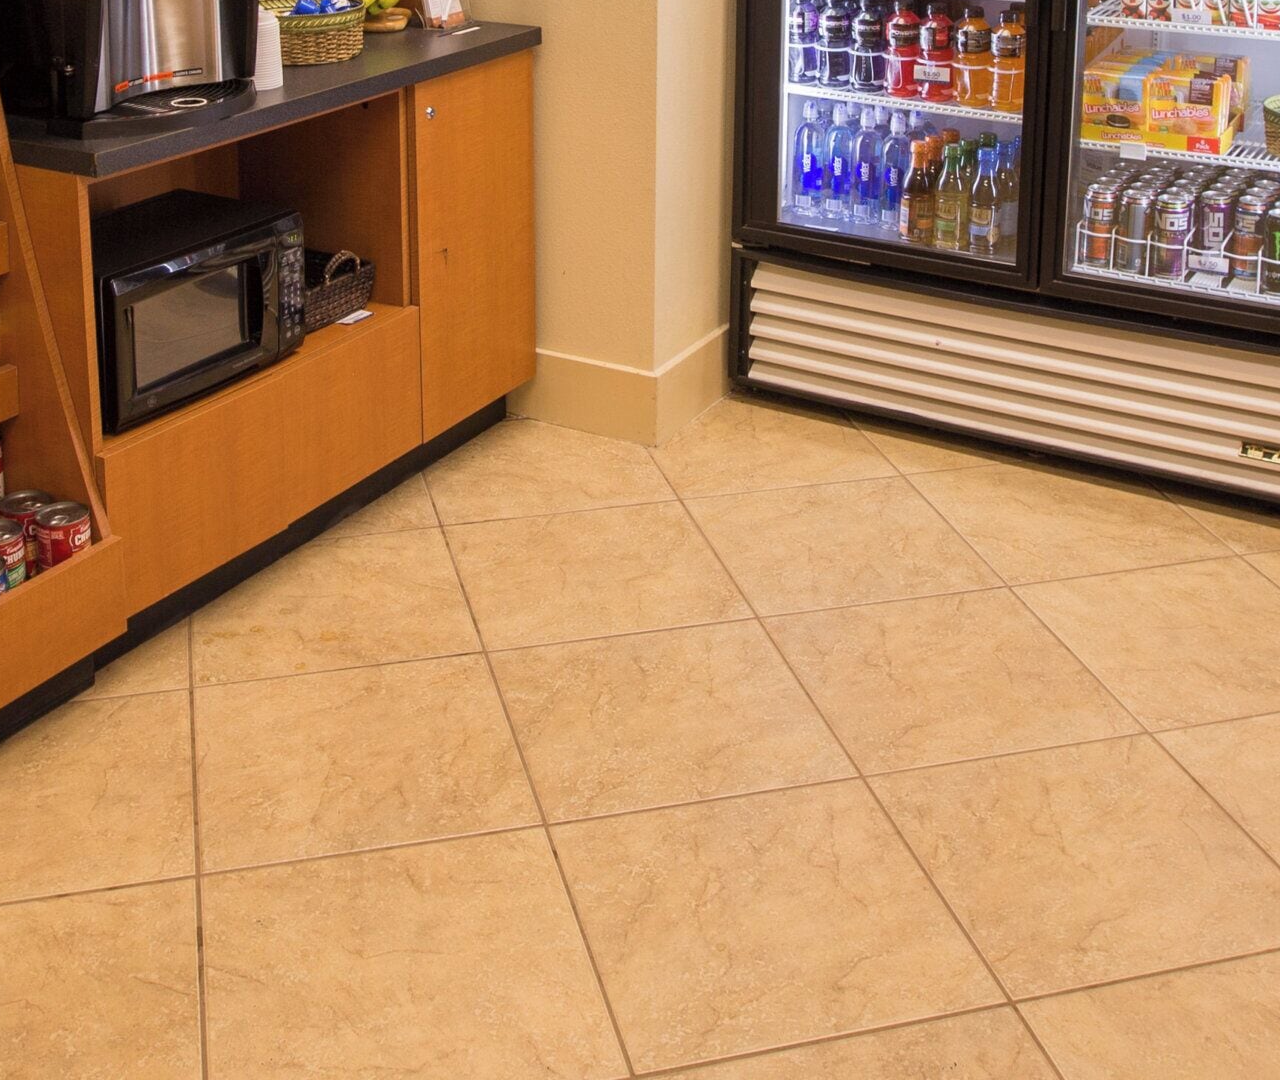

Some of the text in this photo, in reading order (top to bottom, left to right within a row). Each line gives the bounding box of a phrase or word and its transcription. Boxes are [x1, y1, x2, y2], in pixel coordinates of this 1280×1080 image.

[1084, 102, 1141, 115] Lunchables
[1151, 106, 1210, 120] Lunchables
[1156, 212, 1188, 231] NOS
